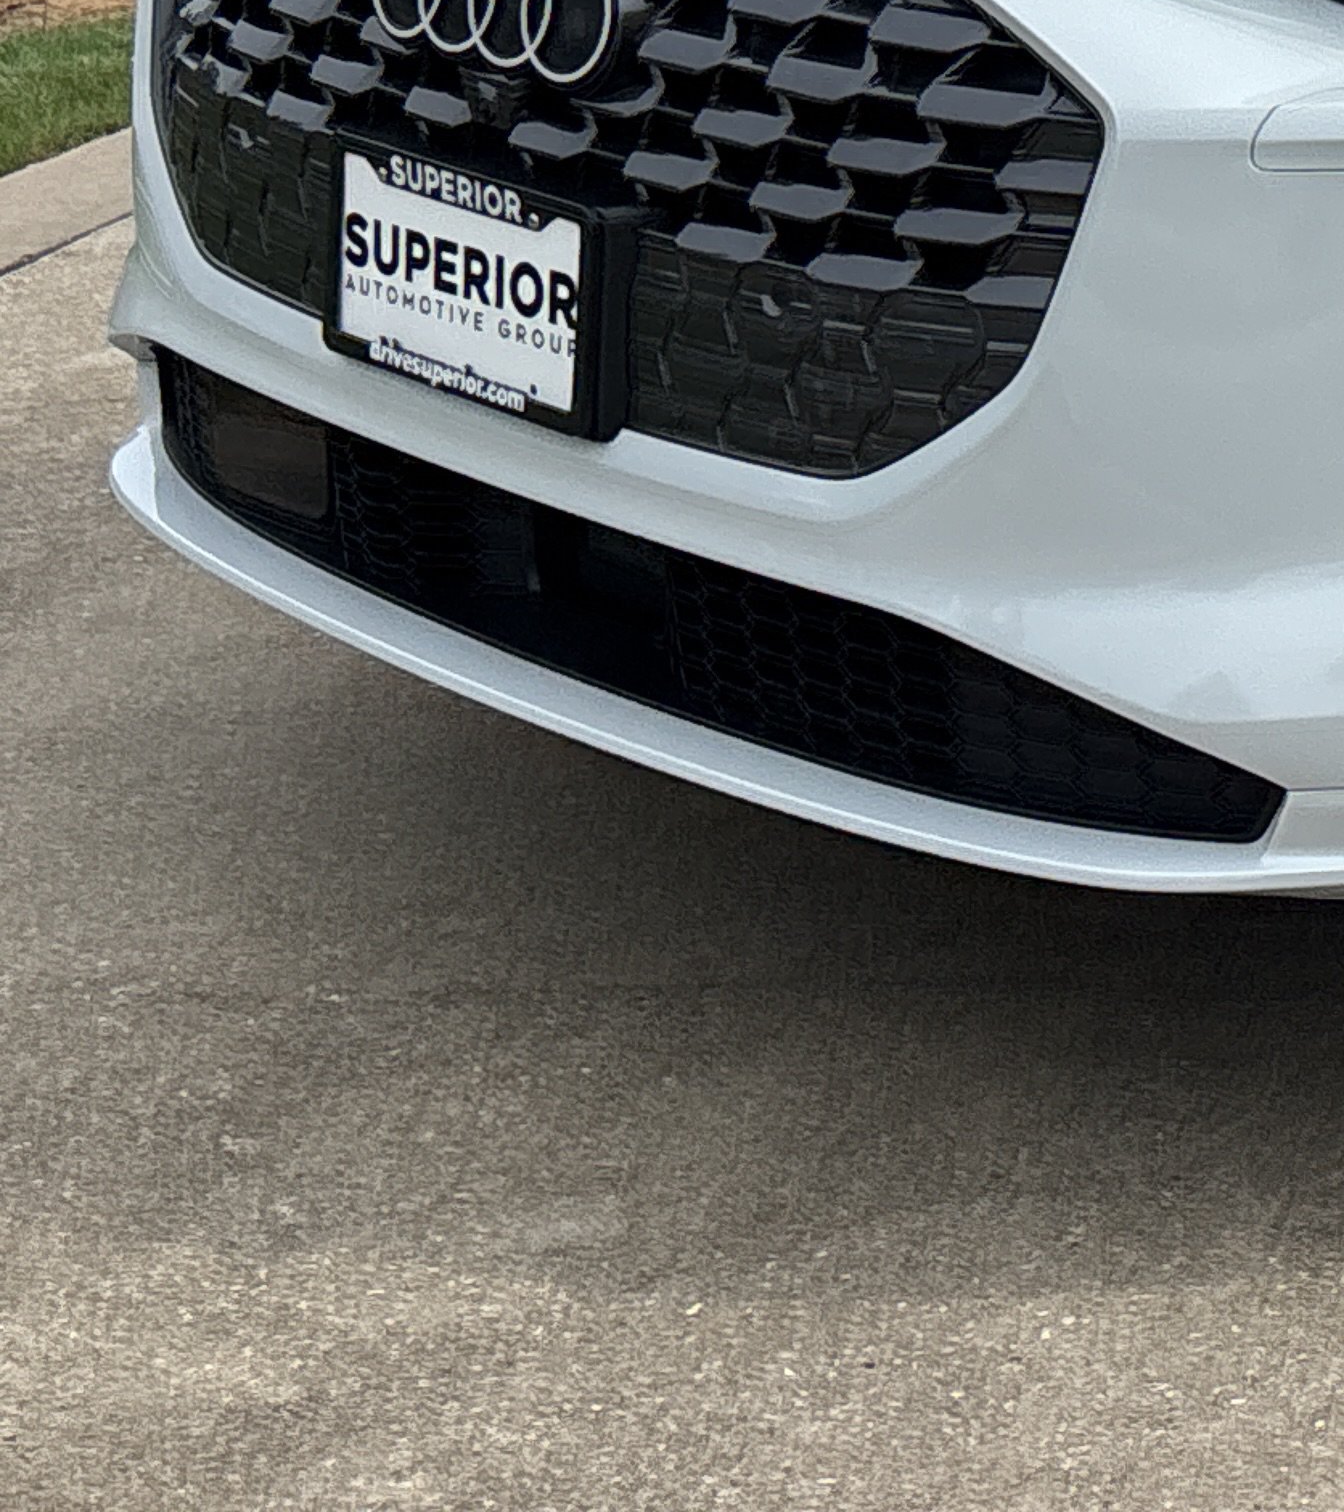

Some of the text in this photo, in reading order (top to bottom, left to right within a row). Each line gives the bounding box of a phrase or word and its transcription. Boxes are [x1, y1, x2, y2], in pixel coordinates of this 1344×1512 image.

[389, 154, 524, 224] SUPERIOR
[344, 211, 577, 331] SUPERIOR
[345, 272, 485, 333] AUTOMOTIVE
[368, 339, 527, 413] drivesuperior.com
